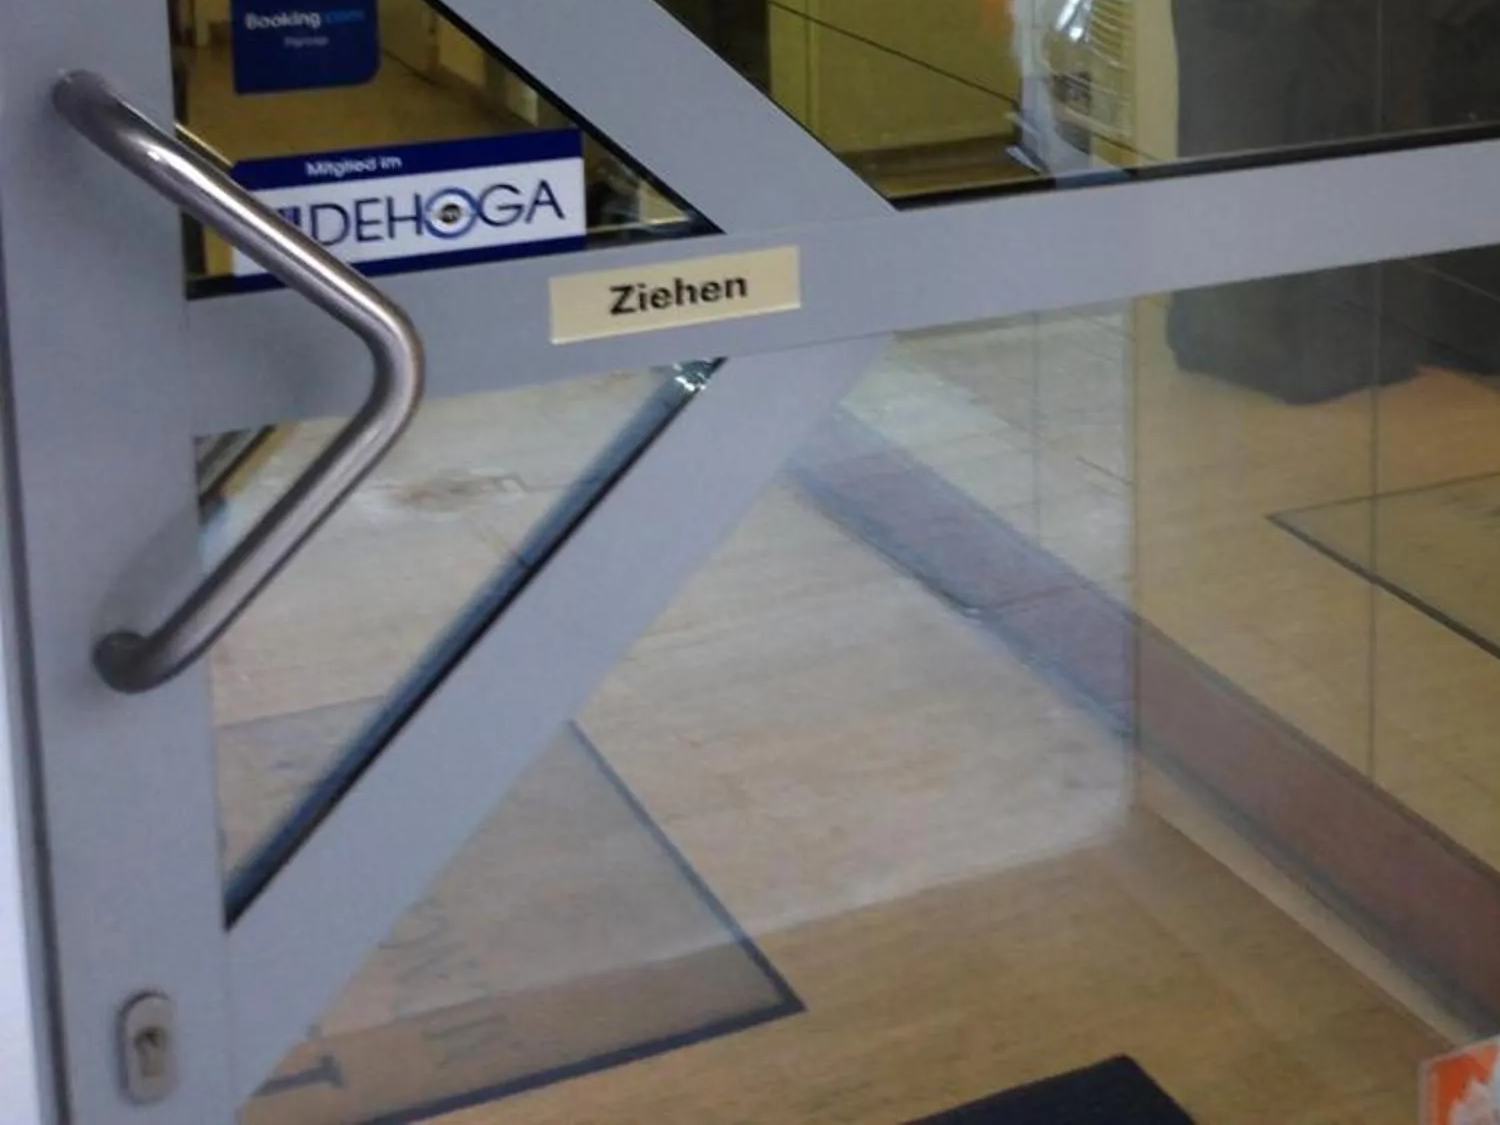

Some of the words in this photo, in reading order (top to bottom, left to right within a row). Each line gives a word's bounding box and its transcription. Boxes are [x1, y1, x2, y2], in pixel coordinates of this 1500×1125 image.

[305, 157, 378, 178] Mitglied
[380, 155, 403, 171] im
[309, 179, 566, 246] DEHOGA
[608, 274, 749, 316] Ziehen
